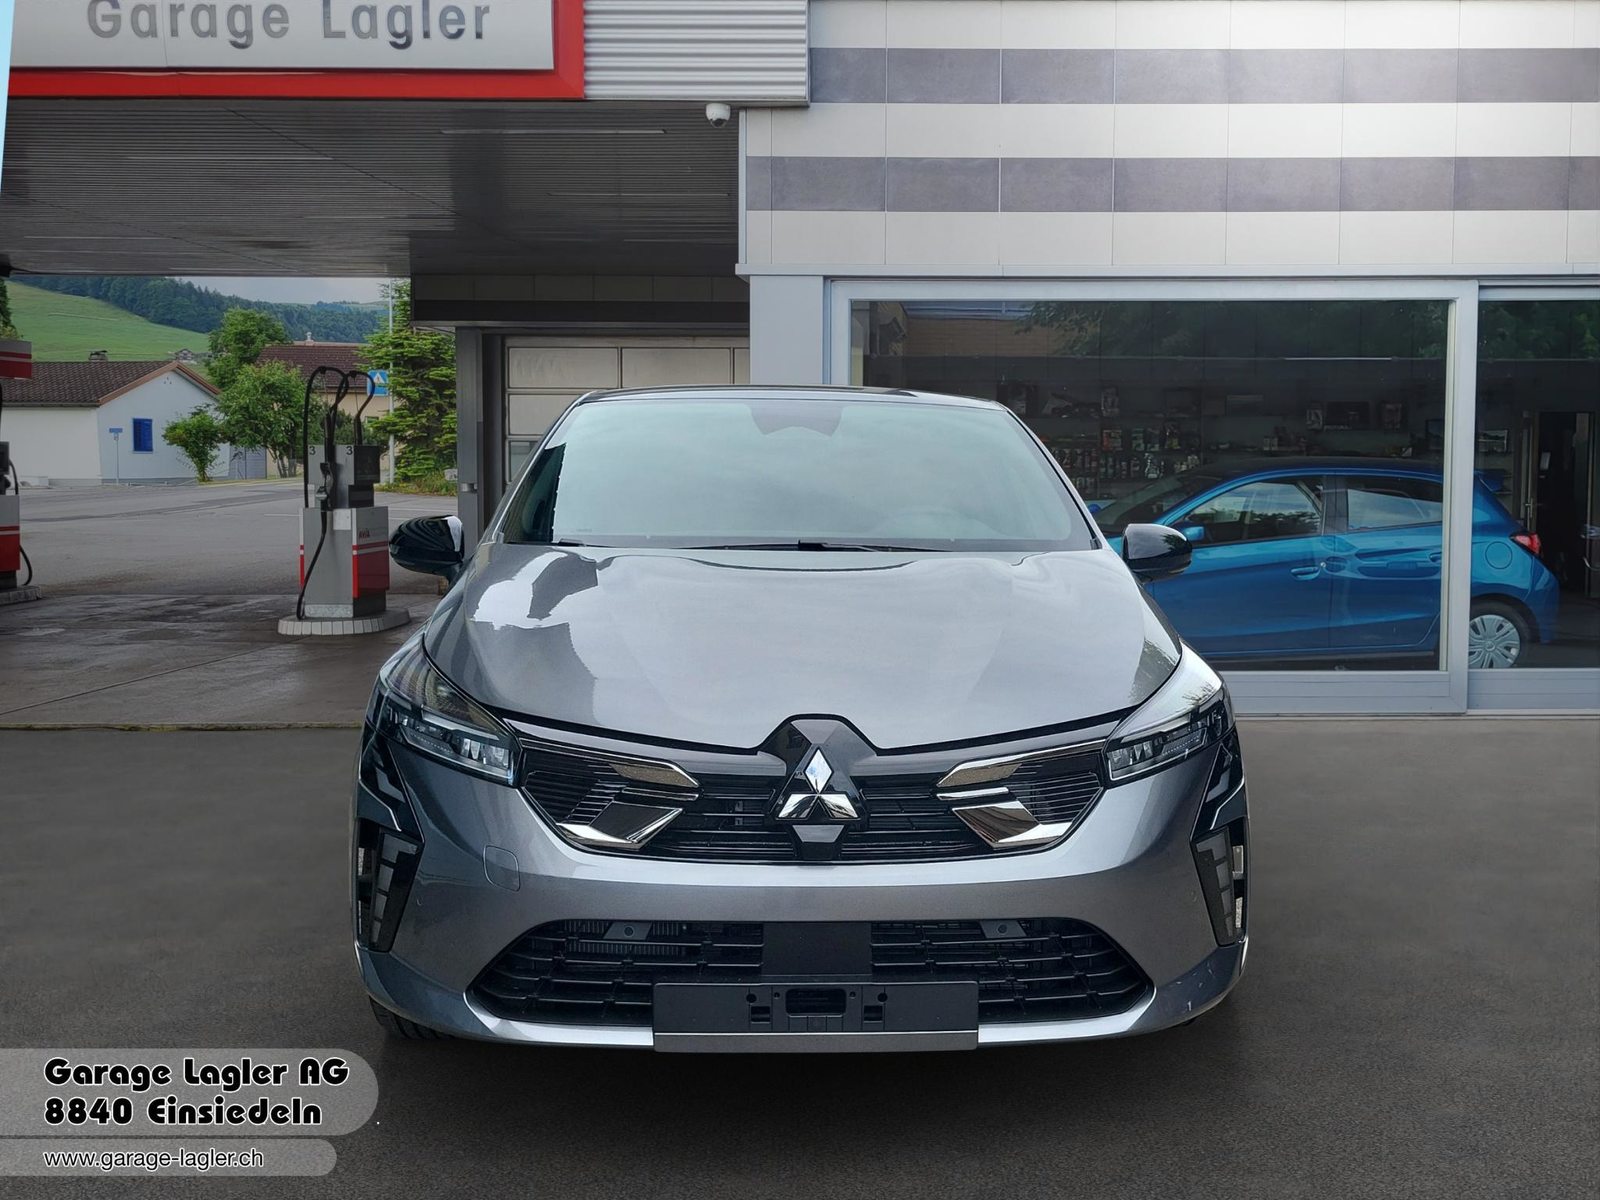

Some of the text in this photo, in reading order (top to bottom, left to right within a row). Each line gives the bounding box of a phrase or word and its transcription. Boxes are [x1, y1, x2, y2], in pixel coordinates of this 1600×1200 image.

[87, 0, 490, 50] Garage Lagler
[309, 446, 316, 455] 3
[346, 446, 353, 455] 3
